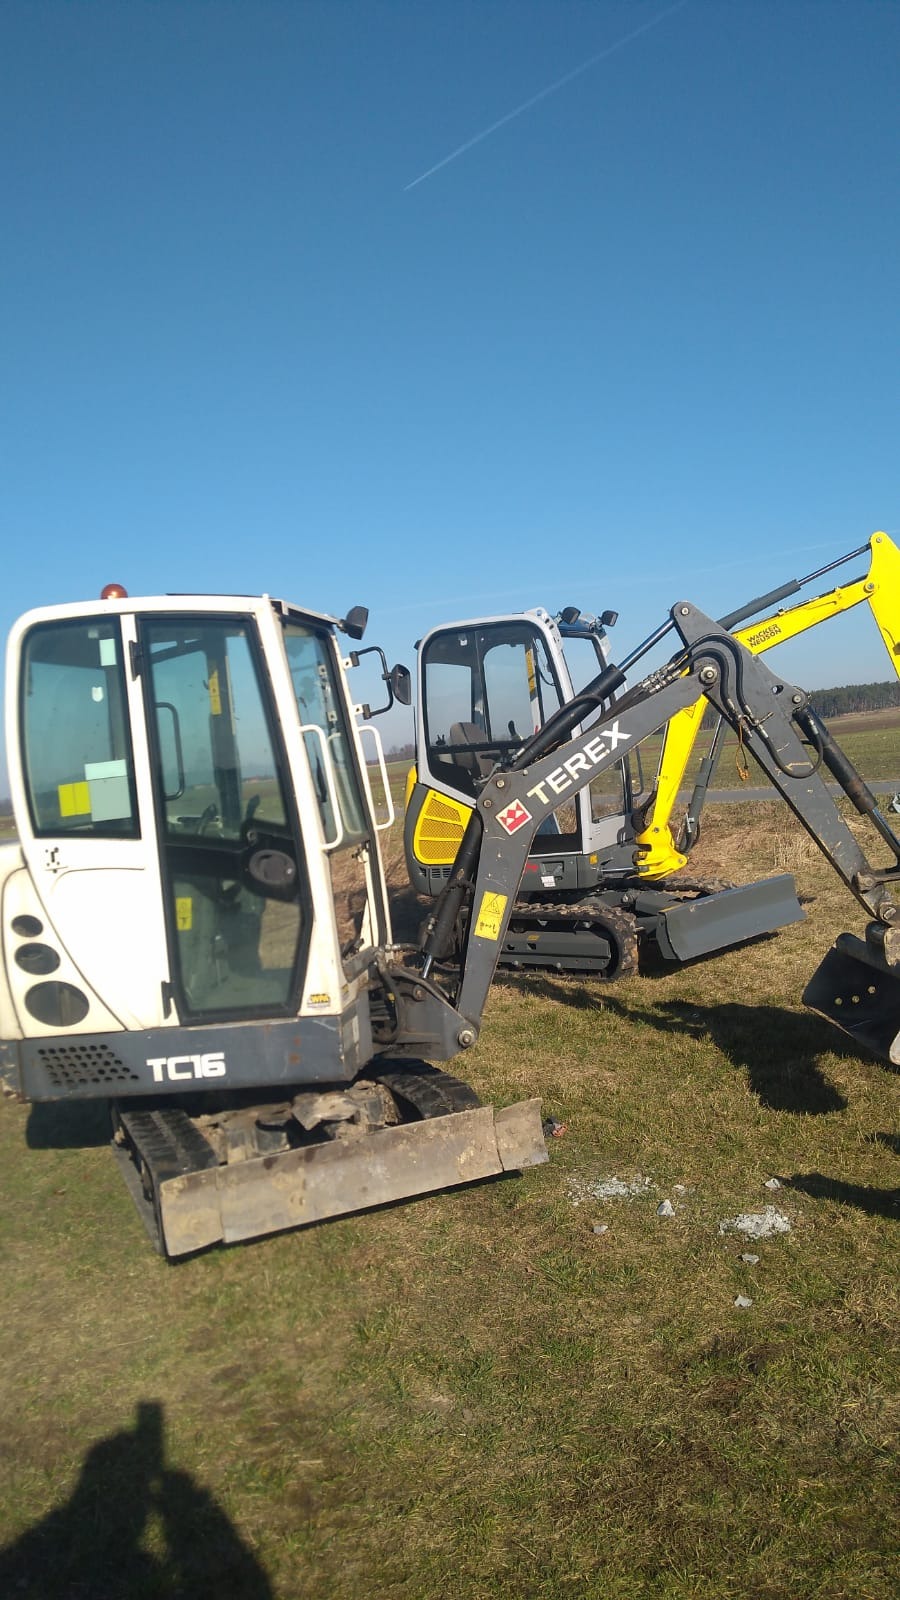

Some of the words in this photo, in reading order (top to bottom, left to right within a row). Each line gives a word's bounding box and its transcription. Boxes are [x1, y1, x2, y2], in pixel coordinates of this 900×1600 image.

[750, 628, 782, 648] NEUSON
[526, 720, 632, 805] TEREX
[146, 1052, 226, 1082] TC16
